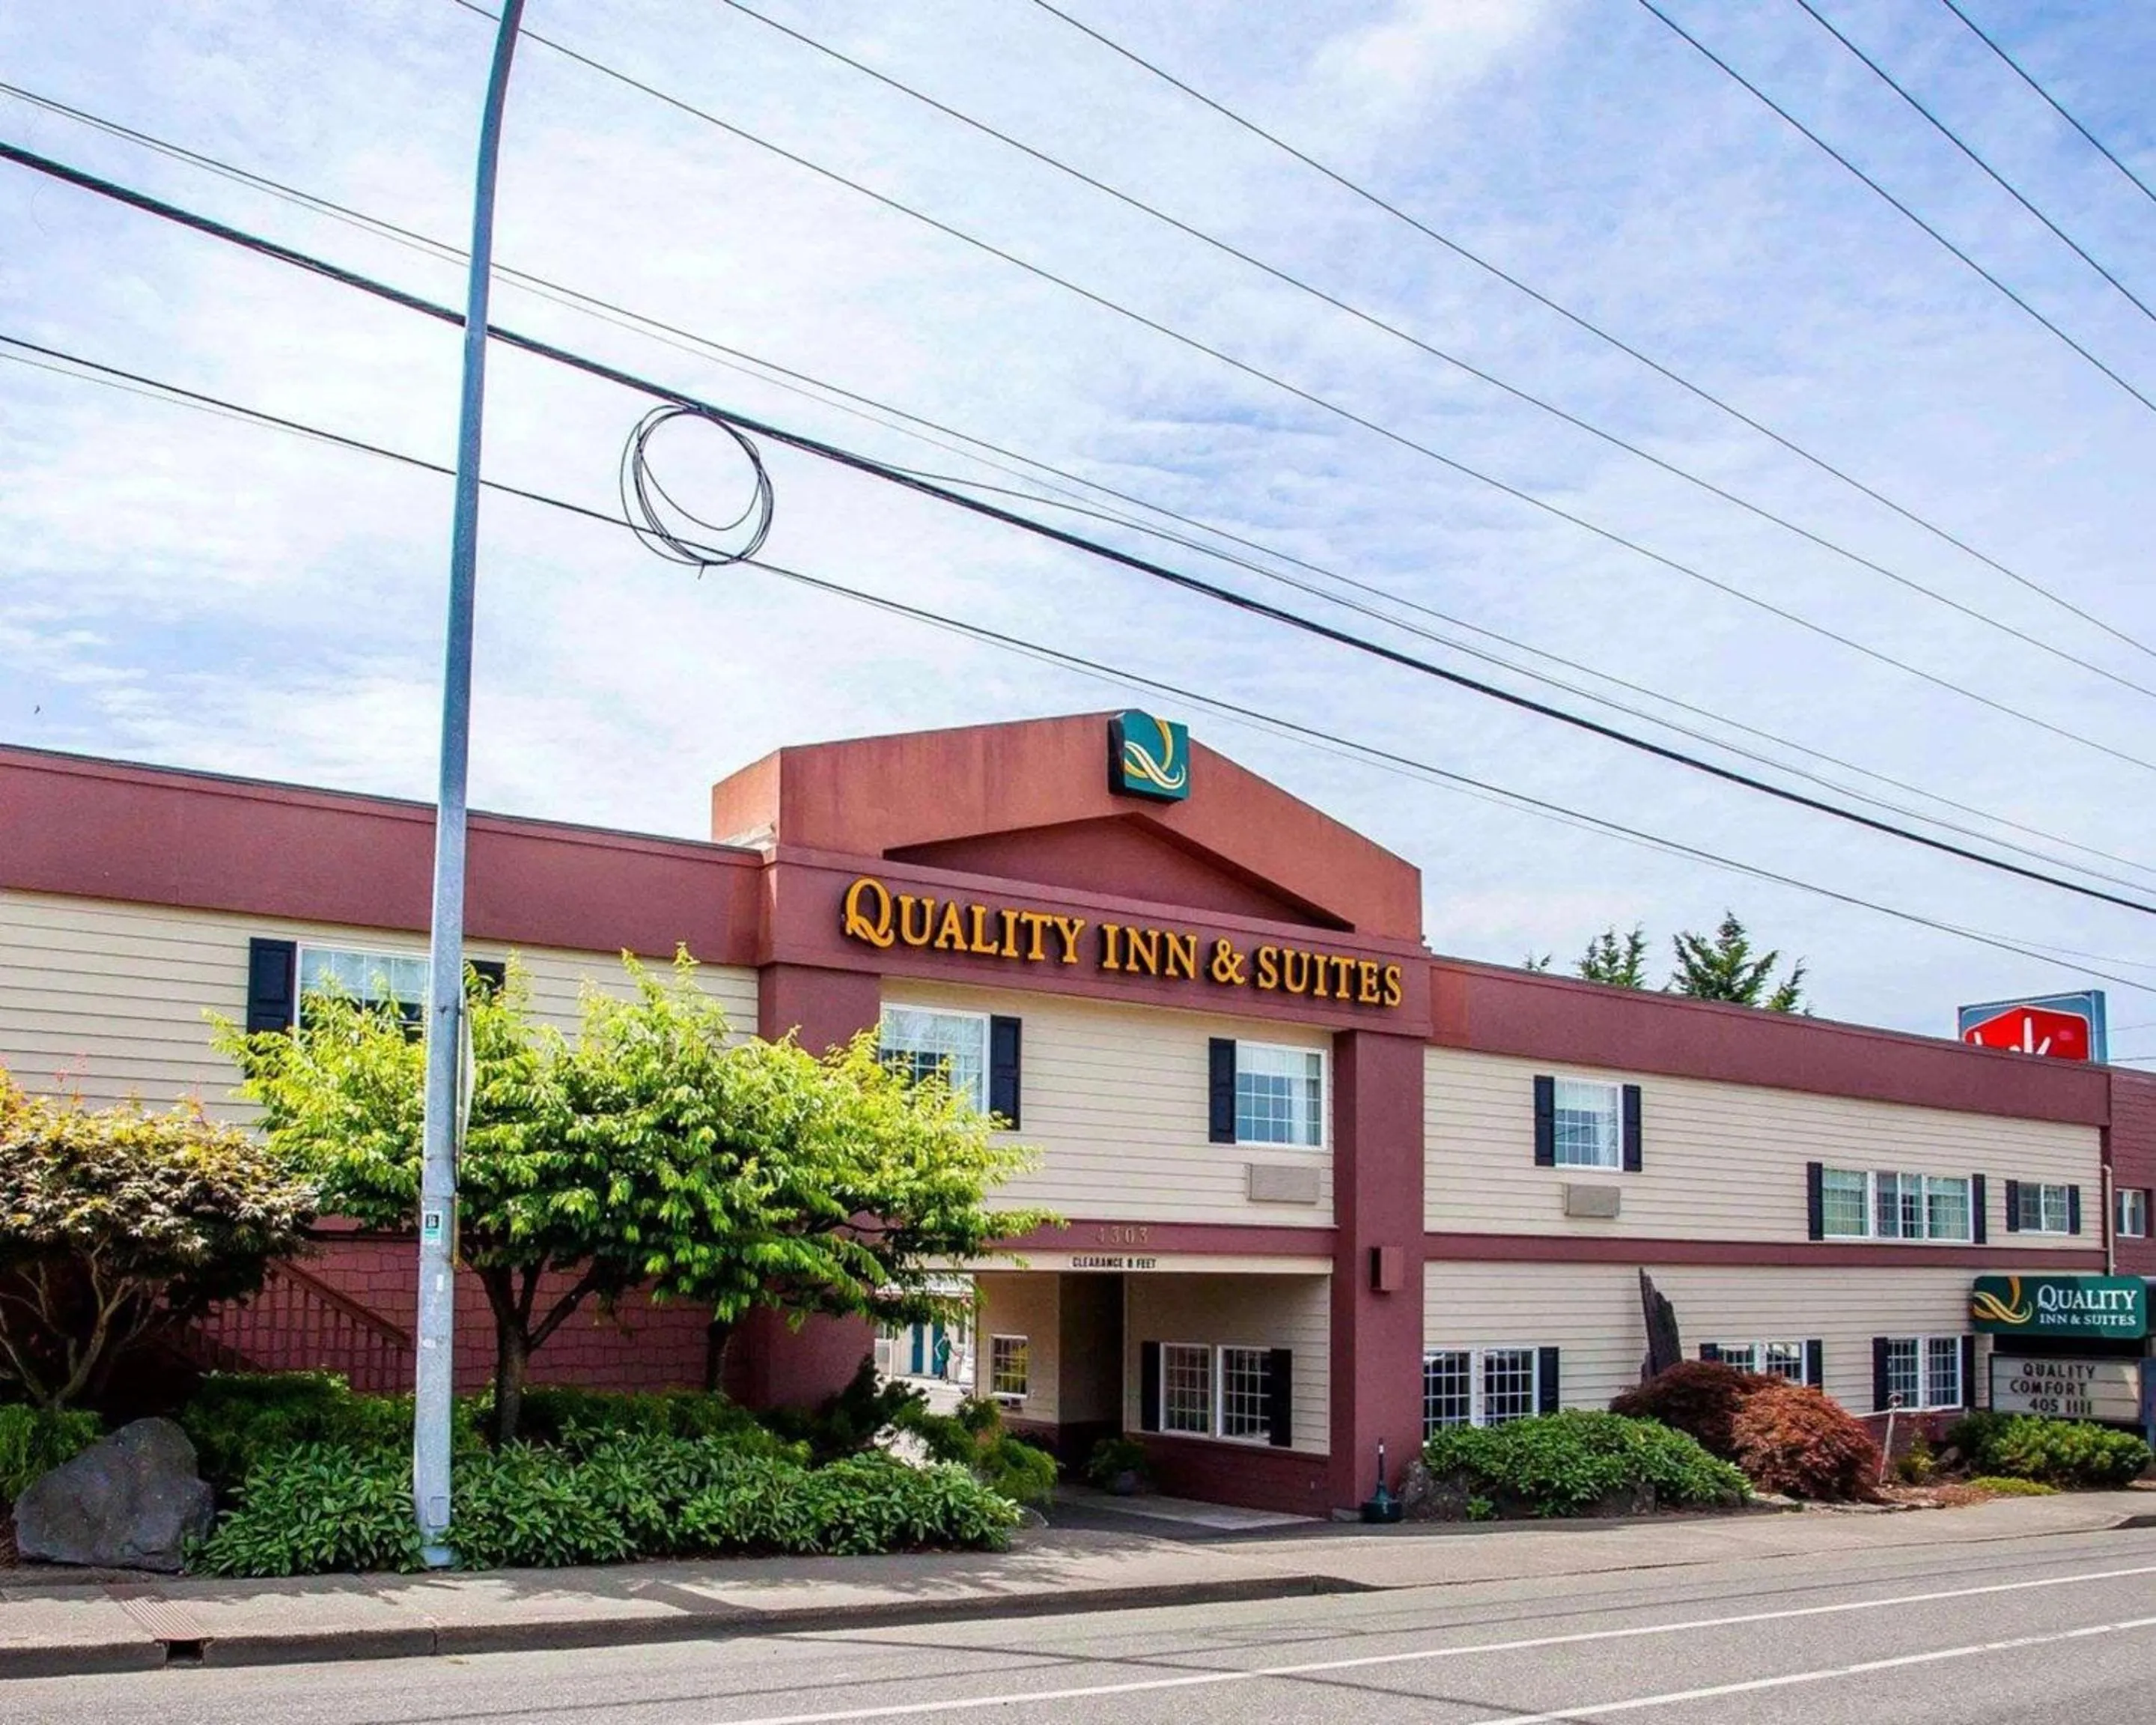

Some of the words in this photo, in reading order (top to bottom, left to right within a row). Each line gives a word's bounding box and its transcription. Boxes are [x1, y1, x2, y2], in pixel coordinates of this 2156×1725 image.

[844, 877, 1085, 964] QUALITY
[1102, 924, 1197, 980] INN
[1212, 938, 1246, 986] &
[1258, 945, 1404, 1008] SUITES
[1072, 1256, 1123, 1268] CLEARANCE
[1127, 1258, 1133, 1268] 8
[1136, 1259, 1157, 1269] FEET
[2037, 1284, 2138, 1312] QUALITY
[2039, 1313, 2068, 1324] INN
[2070, 1315, 2081, 1325] &
[2083, 1314, 2137, 1327] SUITES
[2023, 1363, 2095, 1379] QUALITY
[2009, 1379, 2088, 1396] COMFORT
[2029, 1399, 2059, 1414] 405
